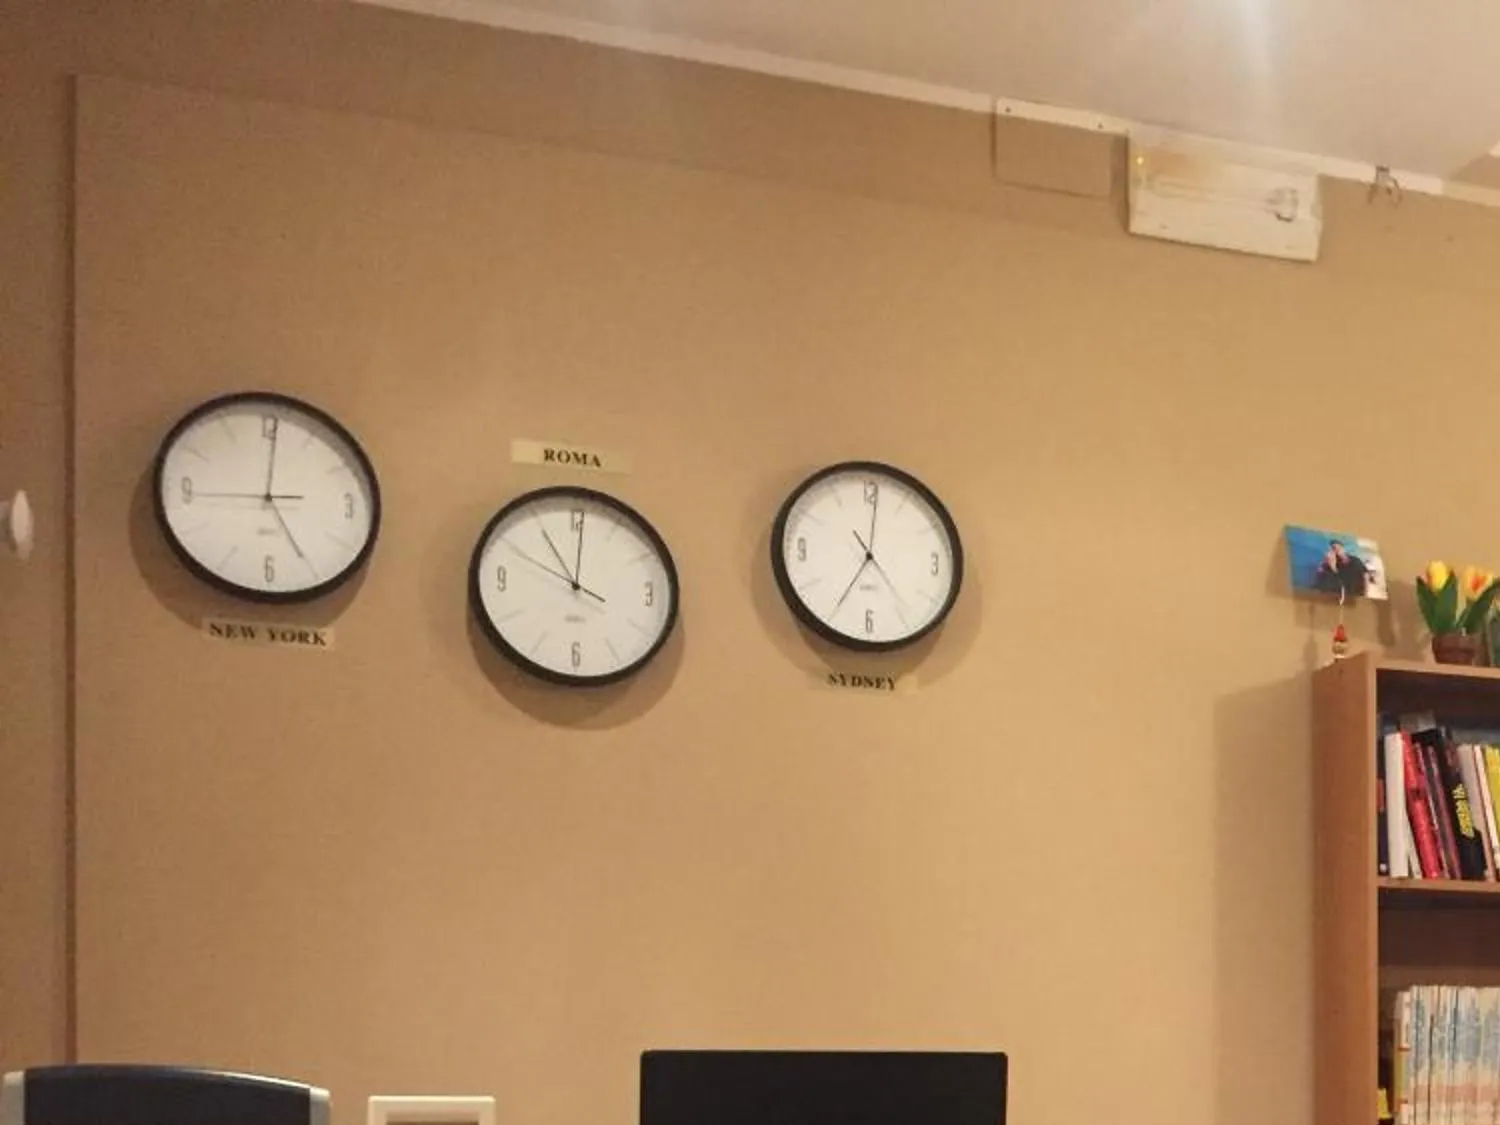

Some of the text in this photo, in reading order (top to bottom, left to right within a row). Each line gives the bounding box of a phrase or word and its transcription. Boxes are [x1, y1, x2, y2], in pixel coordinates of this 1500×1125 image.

[543, 448, 602, 468] ROMA
[181, 475, 193, 504] 9
[862, 480, 878, 504] 12
[344, 492, 354, 519] 3
[797, 537, 807, 562] 9
[264, 555, 275, 583] 6
[930, 552, 940, 576] 3
[497, 564, 507, 592] 9
[644, 581, 654, 607] 3
[864, 609, 874, 633] 6
[209, 622, 327, 647] NEW YORK
[571, 641, 581, 669] 6
[827, 671, 897, 692] SYDNEY
